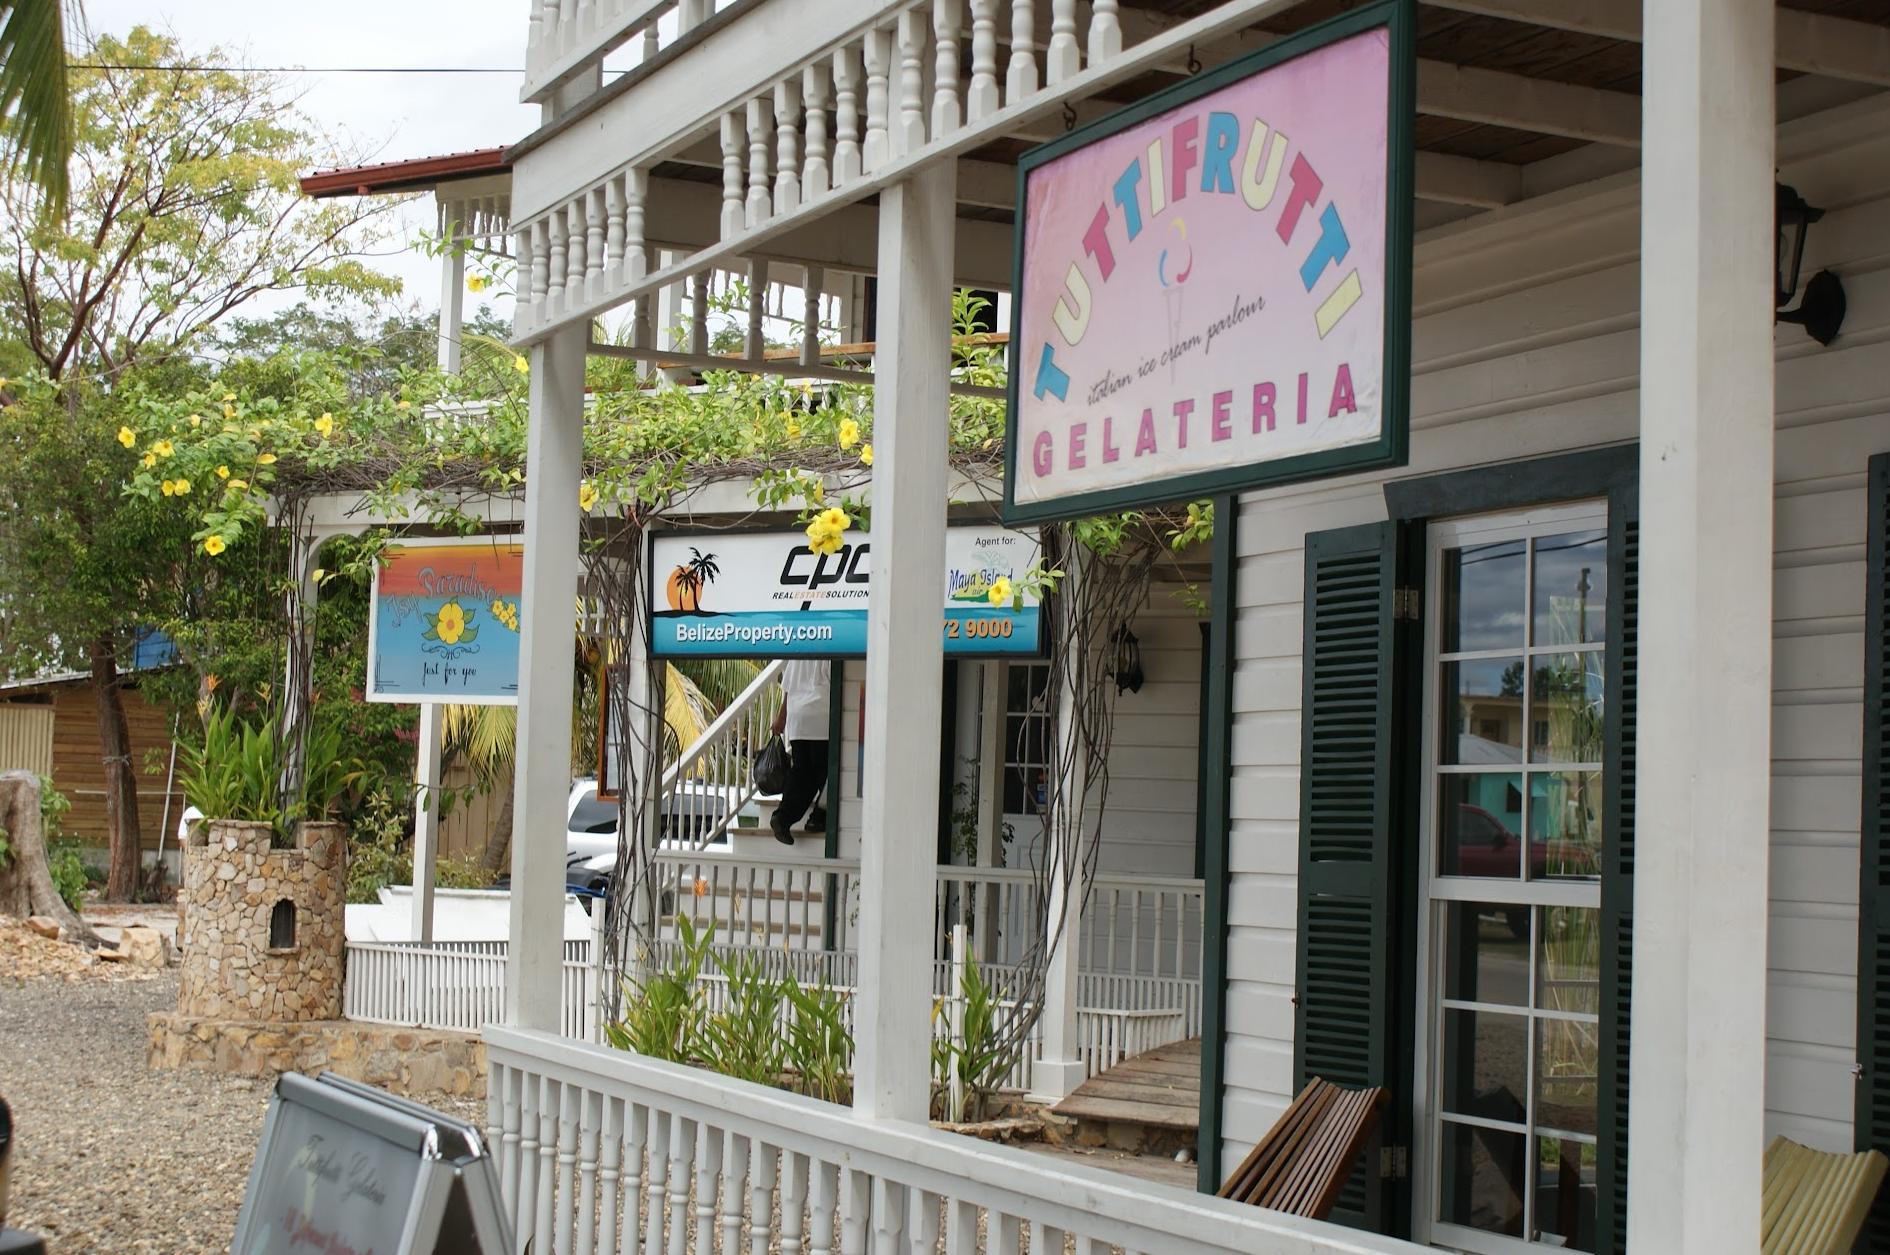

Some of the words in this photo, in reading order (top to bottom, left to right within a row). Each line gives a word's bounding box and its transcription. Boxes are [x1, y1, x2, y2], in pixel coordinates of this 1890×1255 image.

[1034, 111, 1363, 403] TUTTIFRUTTI
[1087, 367, 1133, 407] italian
[1137, 355, 1158, 378] ice
[1160, 333, 1203, 365] cream
[1204, 295, 1266, 354] parlour
[1032, 362, 1359, 478] GELATERIA
[974, 536, 1000, 549] Agent
[1001, 536, 1017, 546] for:
[948, 568, 977, 597] Maya
[979, 567, 1014, 587] Islad
[675, 622, 833, 646] BelizeProperty.com
[964, 617, 1014, 640] 9000
[422, 661, 440, 687] Just
[443, 661, 458, 686] for
[461, 667, 477, 686] you
